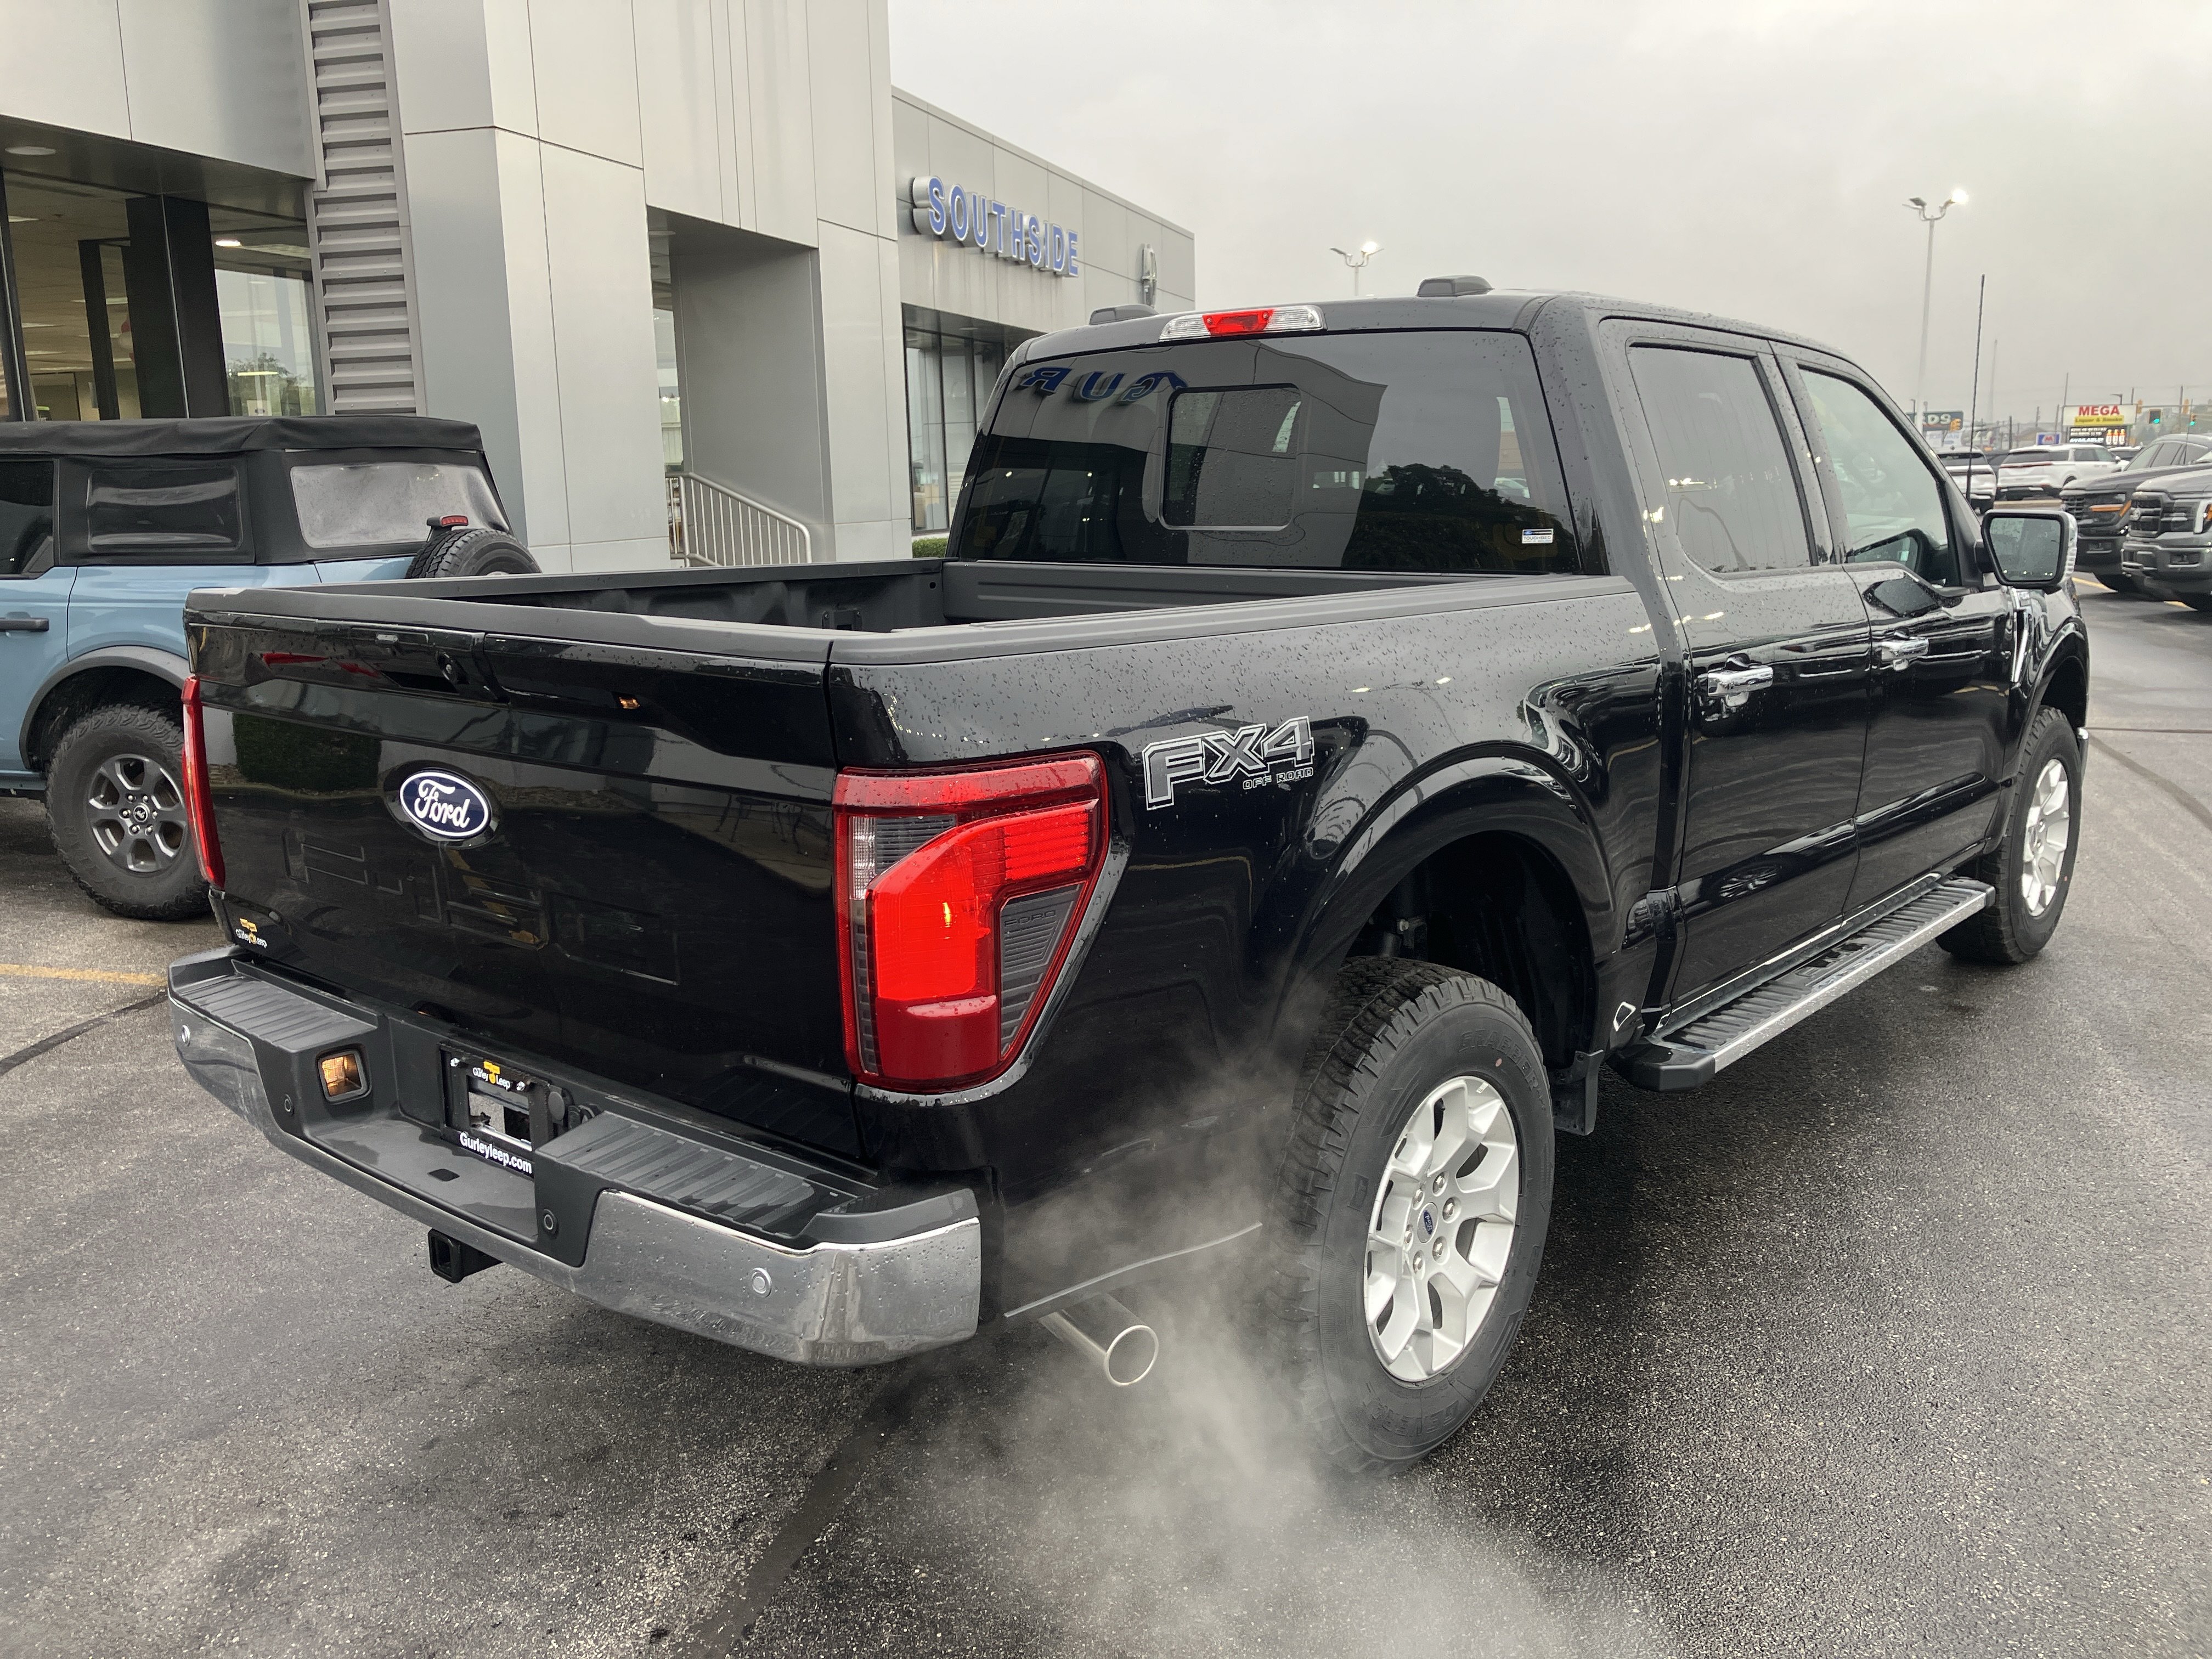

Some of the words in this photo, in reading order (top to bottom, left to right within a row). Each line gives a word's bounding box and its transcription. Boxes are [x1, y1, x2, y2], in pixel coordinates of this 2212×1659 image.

[915, 176, 1079, 278] SOUTHSIDE
[2078, 405, 2120, 416] MEGA
[1142, 716, 1315, 811] FX4
[1242, 775, 1272, 791] OFF
[1276, 766, 1314, 783] ROAD
[414, 778, 471, 829] Ford
[1005, 910, 1056, 927] FORD
[496, 1074, 511, 1090] Leep
[459, 1132, 532, 1174] Gurleyleep.com
